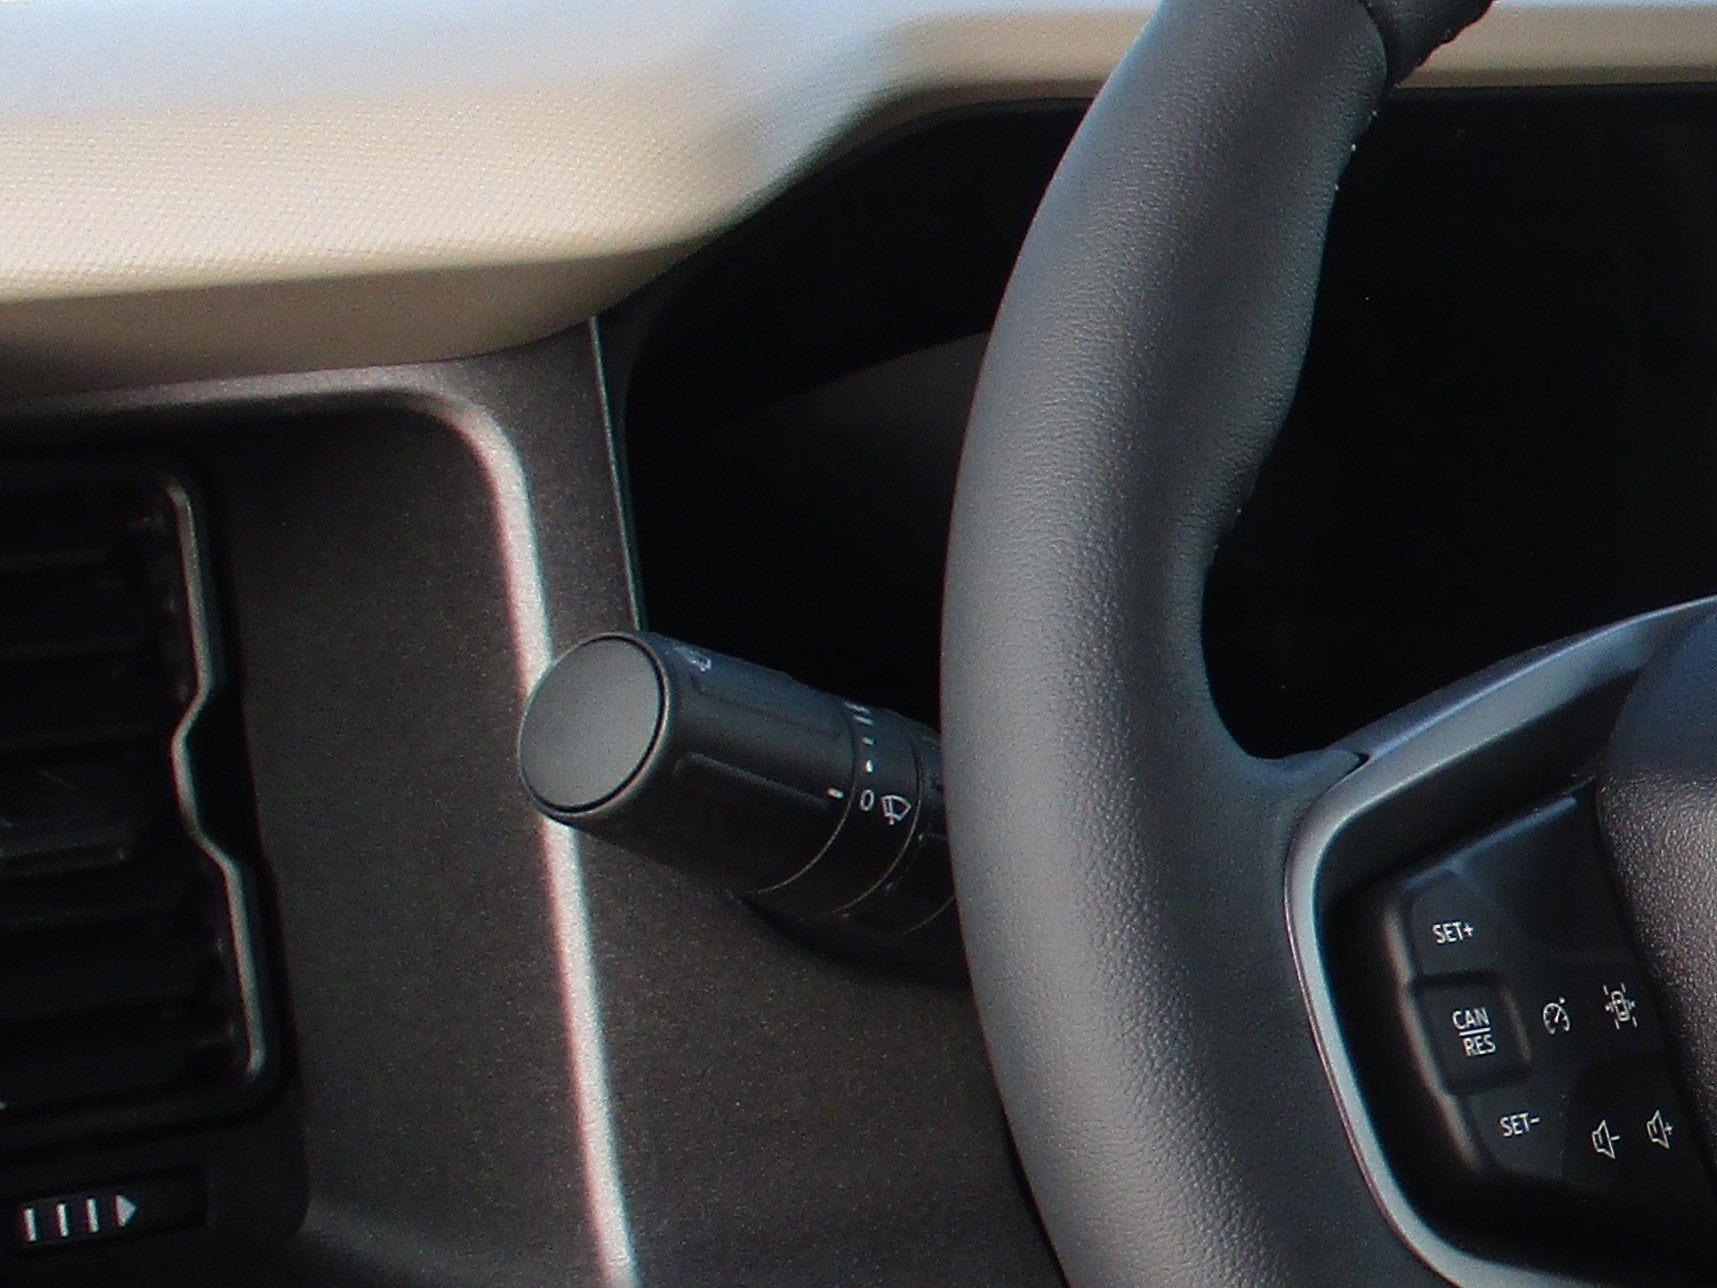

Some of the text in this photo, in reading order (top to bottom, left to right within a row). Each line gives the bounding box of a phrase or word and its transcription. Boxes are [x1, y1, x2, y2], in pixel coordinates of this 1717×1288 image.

[1432, 920, 1475, 945] SET+
[1452, 1006, 1490, 1030] CAN
[1463, 1034, 1497, 1057] RES
